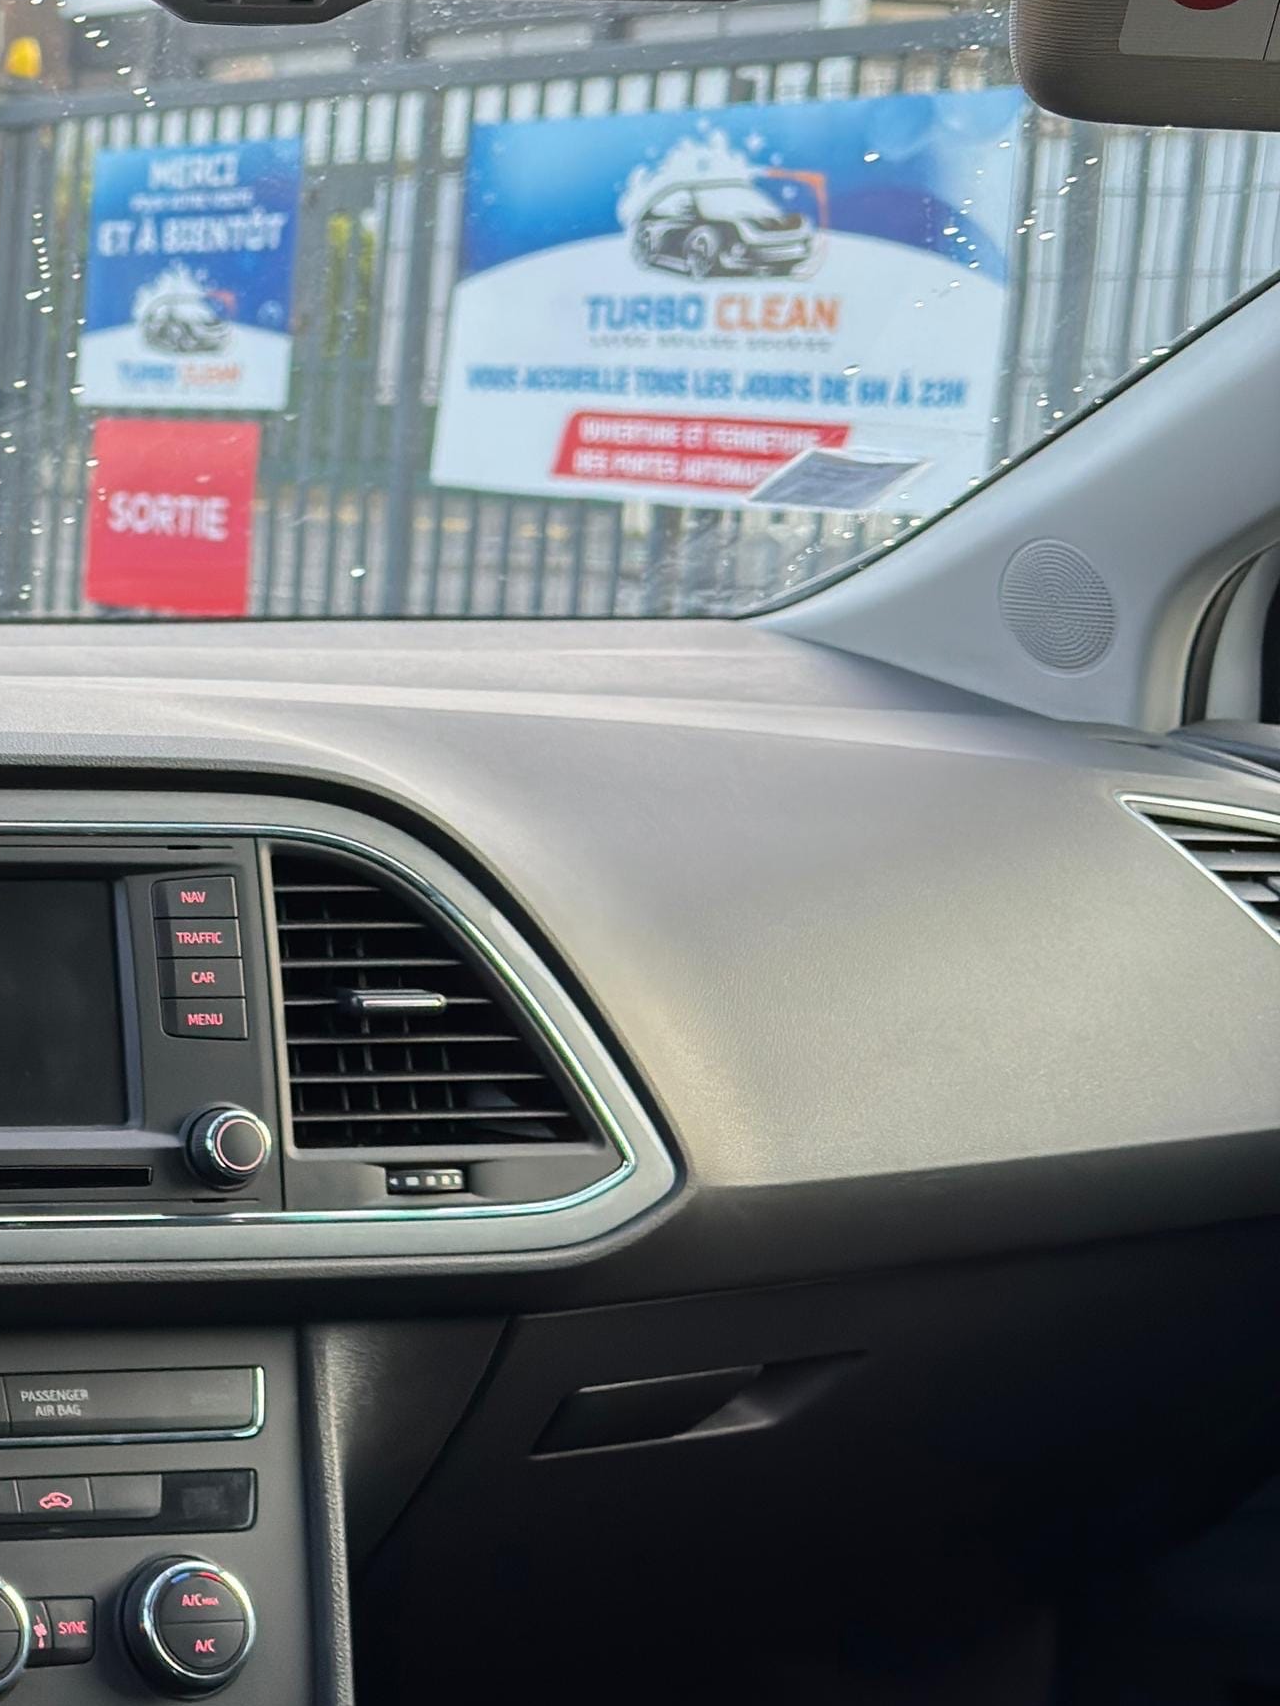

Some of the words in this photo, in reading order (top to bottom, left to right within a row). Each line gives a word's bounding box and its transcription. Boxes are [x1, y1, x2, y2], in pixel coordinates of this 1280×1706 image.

[149, 152, 238, 189] MERCI
[98, 219, 134, 256] ET
[586, 295, 704, 330] TURBO
[715, 295, 840, 332] CLEAN
[108, 491, 229, 541] SORTIE
[180, 891, 206, 903] NAV
[176, 932, 223, 944] TRAFFIC
[191, 971, 216, 984] CAR
[187, 1013, 224, 1026] MENU
[20, 1389, 89, 1402] PASSENGER
[35, 1404, 55, 1417] AIR
[57, 1404, 82, 1417] BAG
[182, 1593, 202, 1606] A/C
[57, 1620, 88, 1635] SYNC
[194, 1639, 216, 1653] A/C
